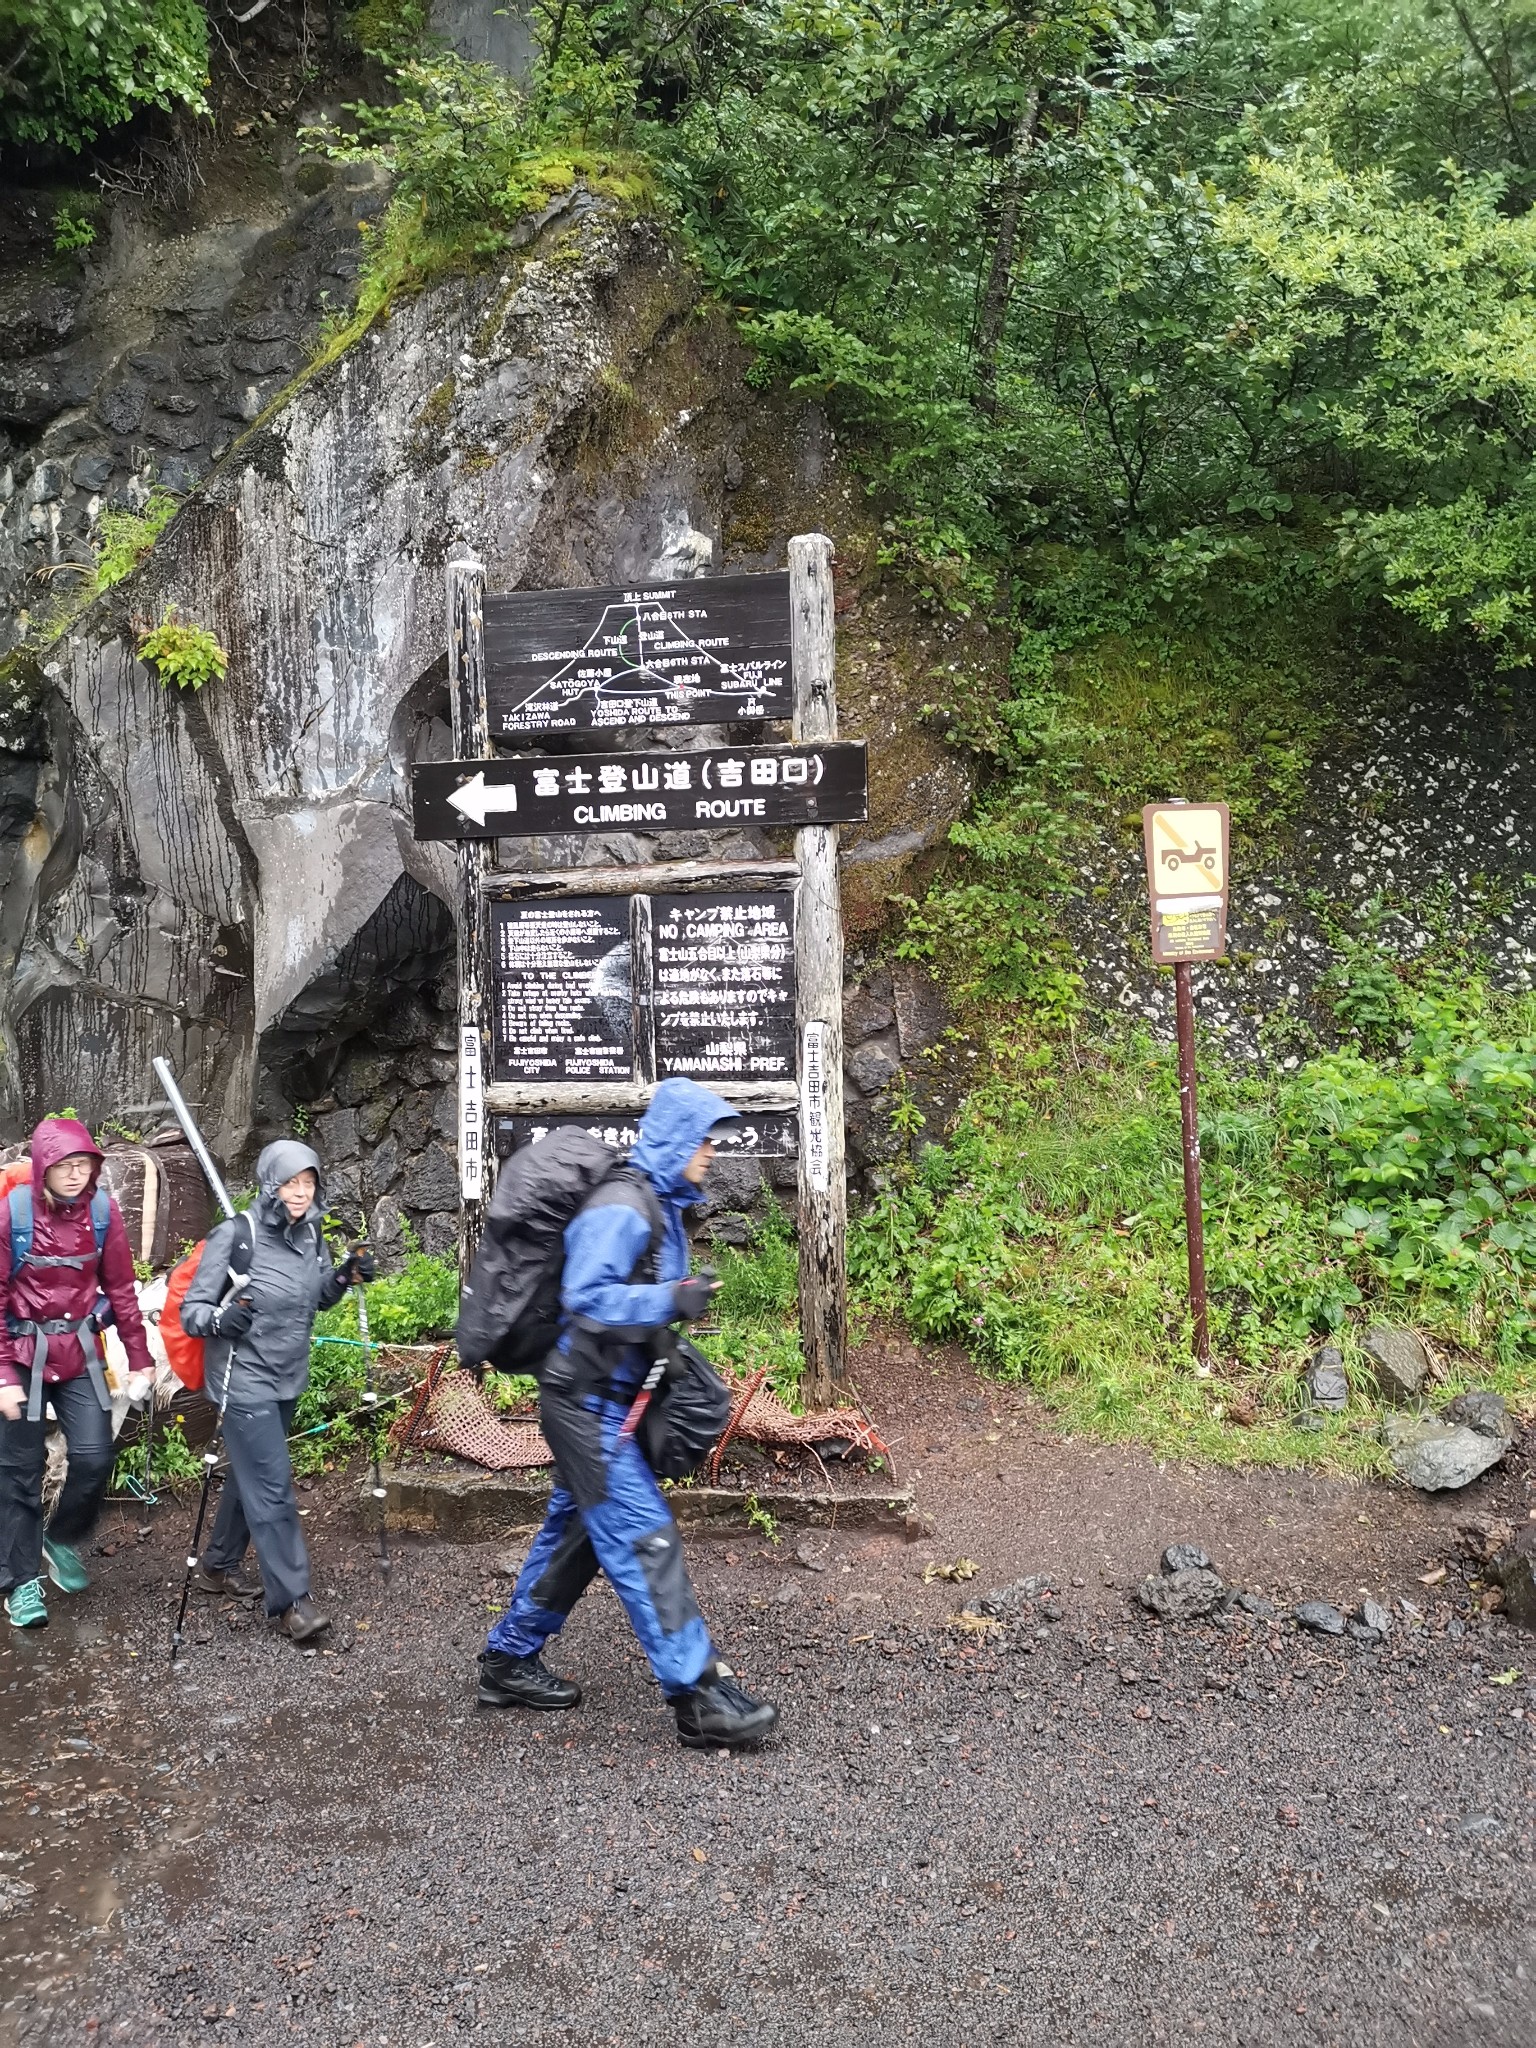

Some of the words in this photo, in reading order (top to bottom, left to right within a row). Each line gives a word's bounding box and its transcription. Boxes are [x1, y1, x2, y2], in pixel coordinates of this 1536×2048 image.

[643, 590, 676, 600] SUMMIT
[688, 610, 707, 618] STA
[654, 640, 694, 650] CLIMBING
[698, 637, 729, 646] ROUTE
[532, 650, 585, 661] DESCENDING
[588, 648, 618, 657] ROUTE
[691, 656, 710, 664] STA
[744, 670, 762, 680] FUJI
[721, 680, 757, 690] SUBARU
[763, 678, 782, 686] LINE
[562, 688, 580, 696] HUT
[665, 691, 684, 700] THIS
[686, 688, 712, 698] POINT
[591, 708, 629, 718] YOSHIDA
[632, 706, 662, 716] ROUTE
[665, 706, 678, 714] TO
[502, 721, 548, 730] FORESTRY
[551, 718, 576, 726] ROAD
[591, 717, 626, 726] ASCEND
[628, 714, 646, 724] AND
[650, 712, 690, 722] DESCEND
[573, 802, 666, 824] CLIMBING
[696, 798, 766, 820] ROUTE
[670, 904, 776, 922] キャンプ禁止地域
[500, 930, 506, 938] 2
[659, 924, 678, 940] NO
[686, 922, 744, 938] CAMPING
[752, 922, 788, 937] AREA
[522, 972, 534, 980] TO
[540, 972, 556, 980] THE
[502, 1004, 506, 1012] 3
[502, 1012, 506, 1020] 4
[706, 1042, 748, 1056] 山梨県
[524, 1066, 540, 1074] CITY
[566, 1066, 591, 1074] POLICE
[598, 1066, 630, 1074] STATION
[663, 1057, 742, 1072] YAMANASHI
[750, 1056, 788, 1072] PREF.
[464, 1034, 478, 1181] 富士吉田市
[806, 1032, 823, 1176] 富士吉田市観光協会
